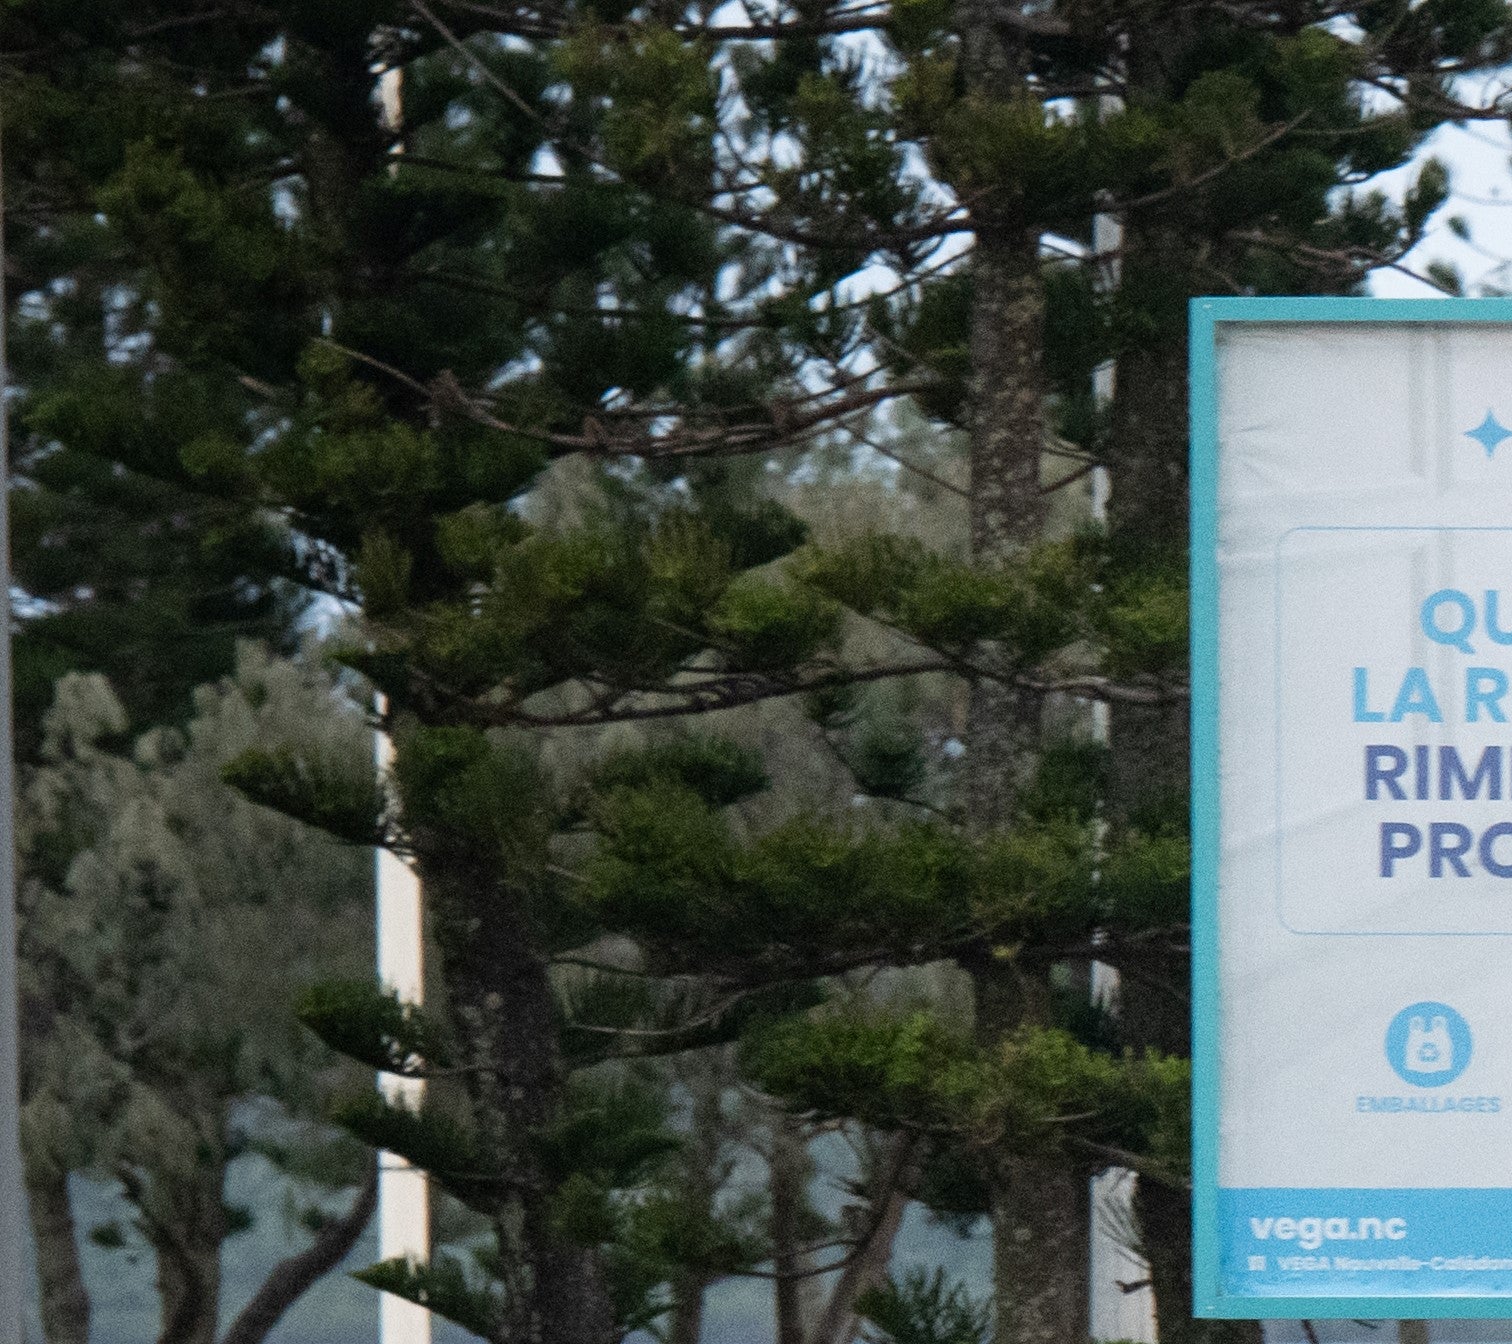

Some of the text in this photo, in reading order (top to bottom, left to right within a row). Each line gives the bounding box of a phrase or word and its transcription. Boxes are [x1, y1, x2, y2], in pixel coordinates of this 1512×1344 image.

[1352, 667, 1443, 724] LA
[1356, 1096, 1501, 1114] EMBALLAGES
[1250, 1217, 1408, 1250] vega.nc
